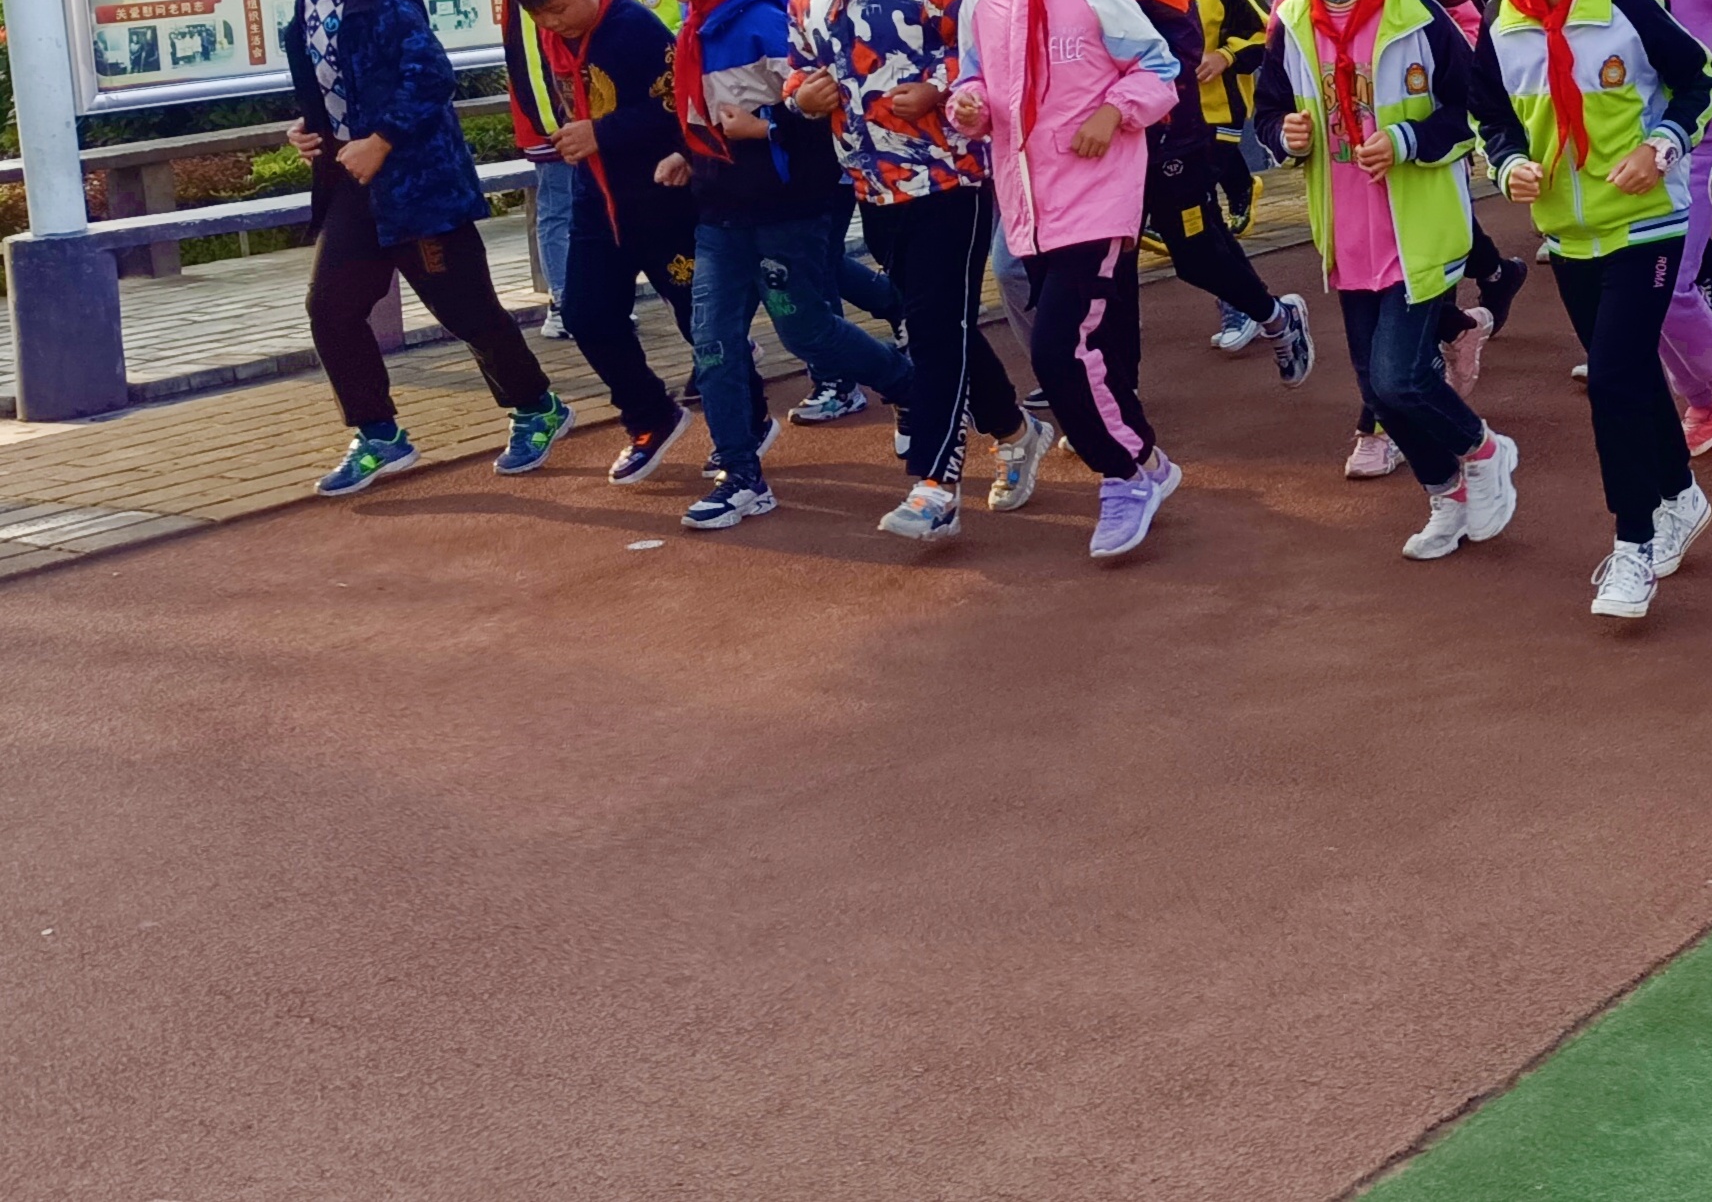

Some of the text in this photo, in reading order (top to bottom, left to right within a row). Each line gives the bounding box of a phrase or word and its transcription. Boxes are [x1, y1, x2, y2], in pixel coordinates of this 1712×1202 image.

[115, 0, 206, 20] 关爱慰问老同志
[246, 0, 262, 59] 组织生活会
[1653, 255, 1667, 288] ROMA
